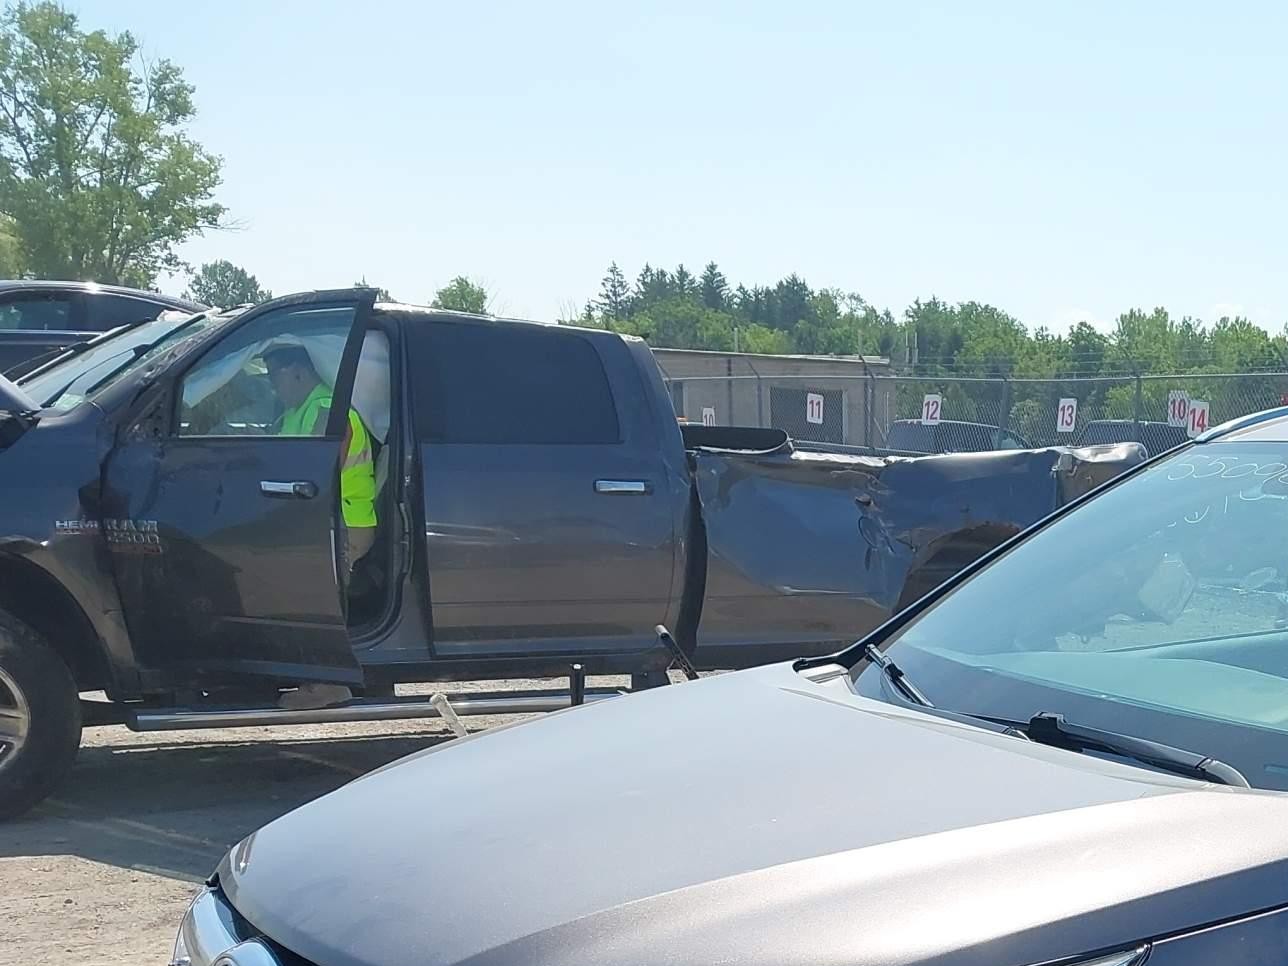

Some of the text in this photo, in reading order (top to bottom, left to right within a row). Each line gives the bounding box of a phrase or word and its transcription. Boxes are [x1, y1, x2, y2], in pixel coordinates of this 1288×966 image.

[809, 399, 822, 419] 11
[924, 400, 939, 421] 12
[1059, 404, 1075, 427] 13
[1170, 399, 1187, 420] 10
[1189, 407, 1207, 433] 14
